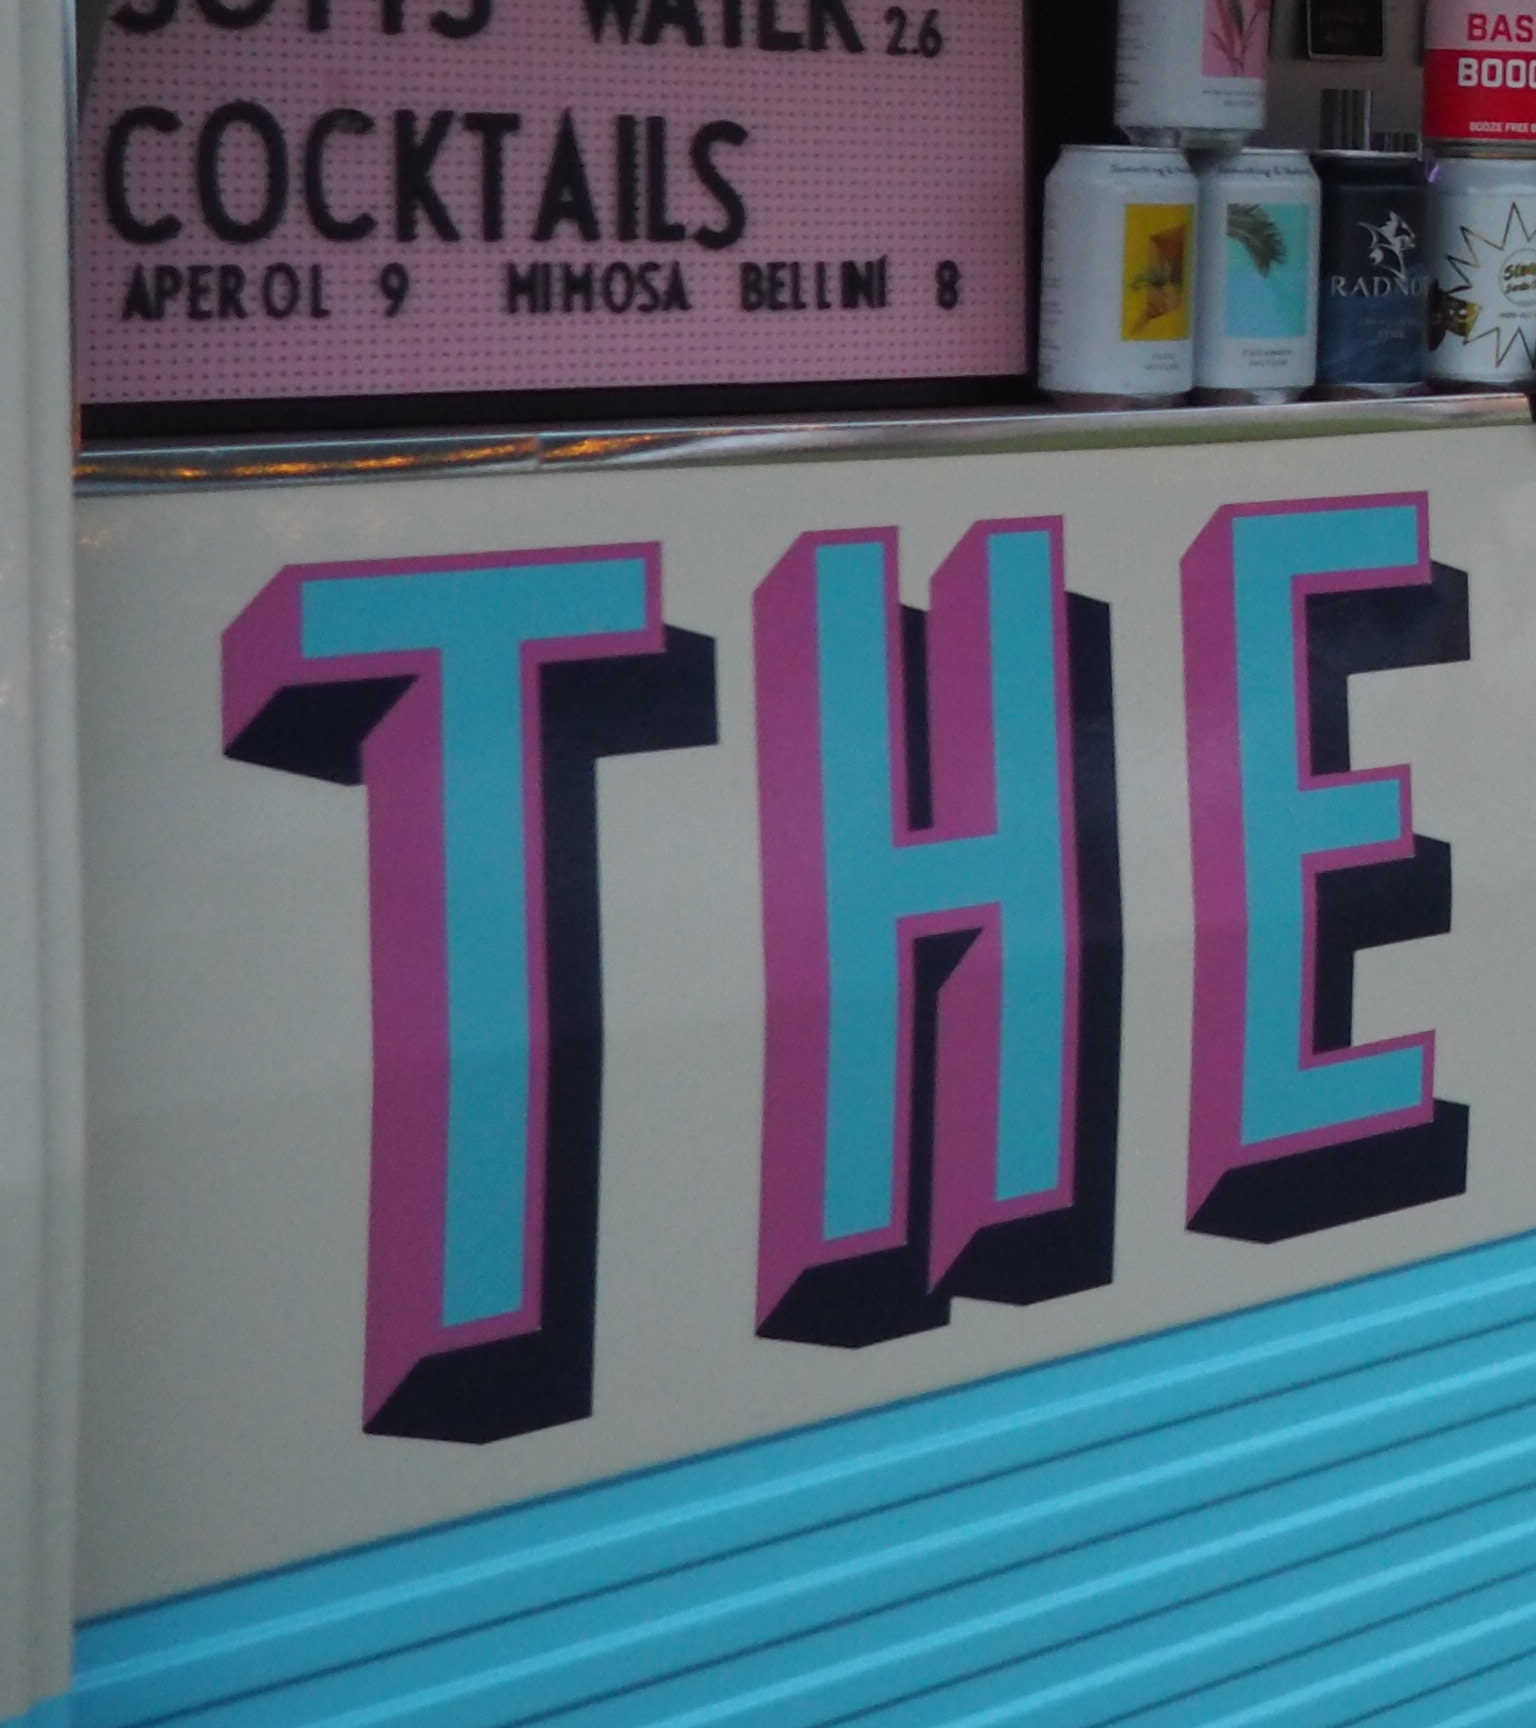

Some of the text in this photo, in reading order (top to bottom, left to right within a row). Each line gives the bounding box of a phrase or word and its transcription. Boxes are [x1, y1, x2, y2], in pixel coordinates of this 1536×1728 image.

[104, 100, 750, 252] COCKTAILS
[120, 255, 961, 321] APEROL 9 MIMOSA BELLINI 8
[1330, 275, 1429, 298] RADNO
[222, 490, 1473, 1445] THE
